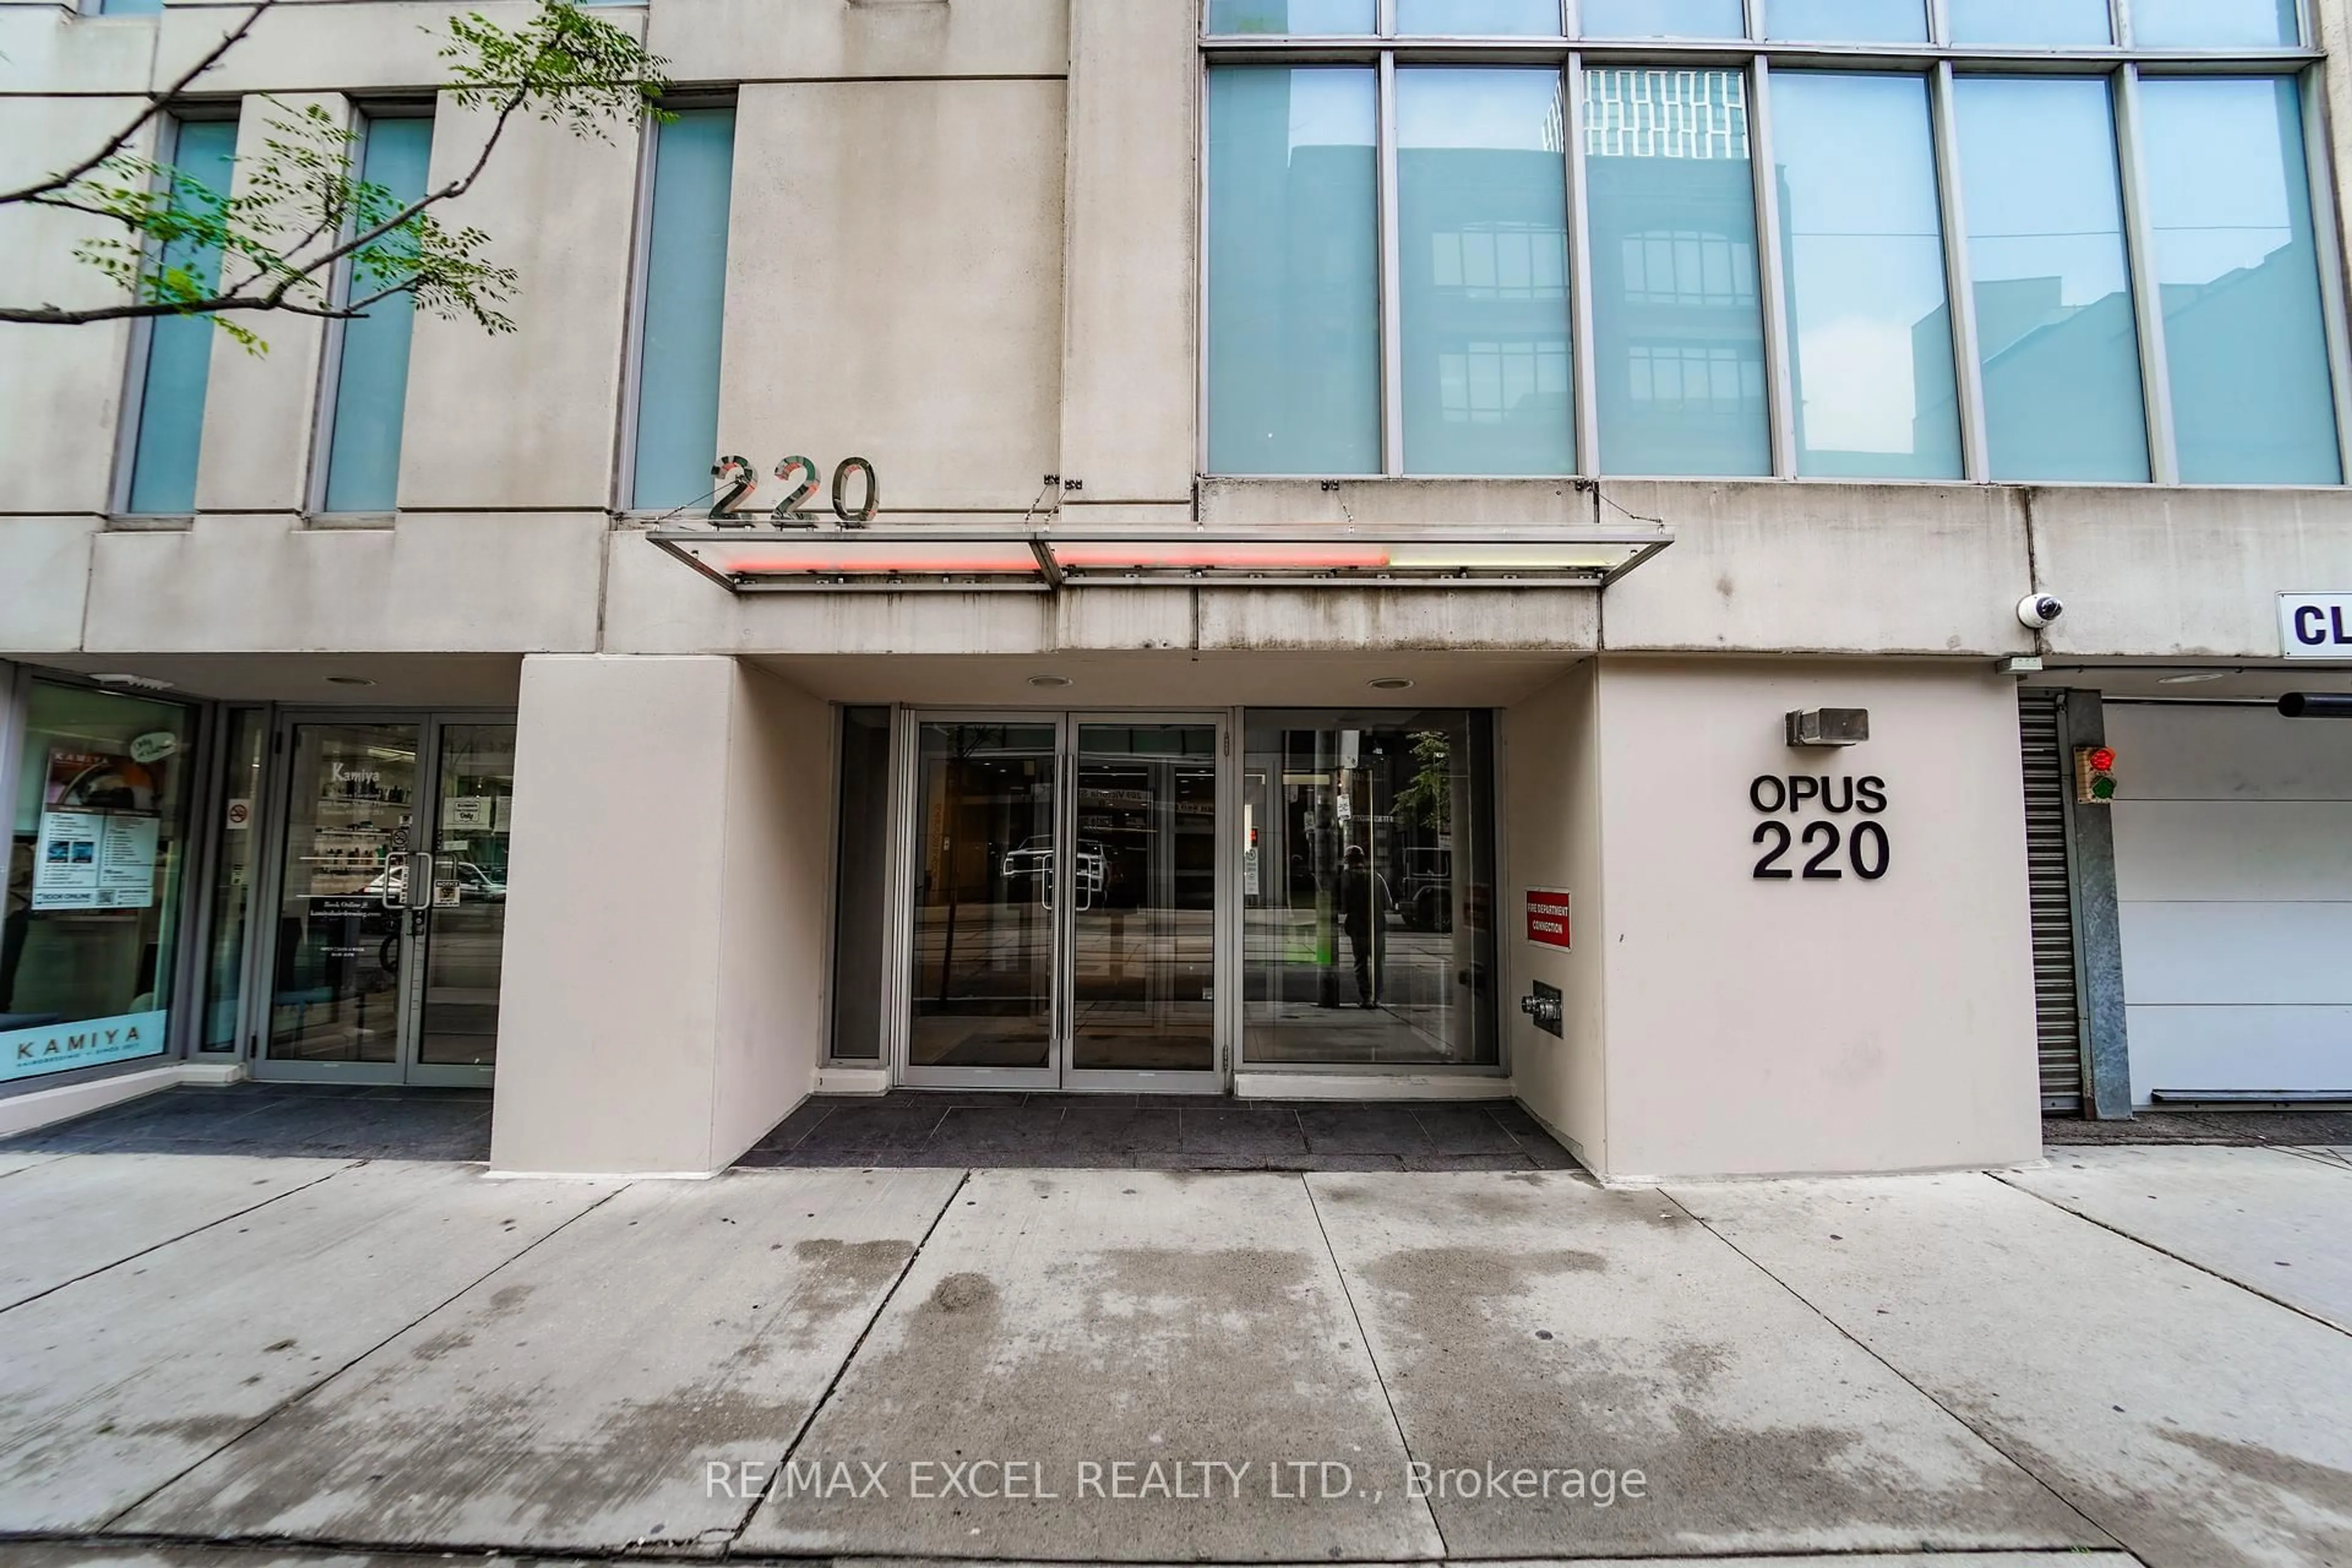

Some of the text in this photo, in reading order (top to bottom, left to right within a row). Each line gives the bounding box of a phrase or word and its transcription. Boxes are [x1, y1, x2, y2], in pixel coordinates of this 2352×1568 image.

[707, 455, 881, 522] 220
[332, 762, 380, 785] Kamiya
[1750, 775, 1887, 813] OPUS
[1753, 820, 1890, 880] 220
[1527, 903, 1569, 917] FIRE DEPARTMENT
[1532, 920, 1563, 934] CONNECTION
[17, 1026, 140, 1060] KAMIYA
